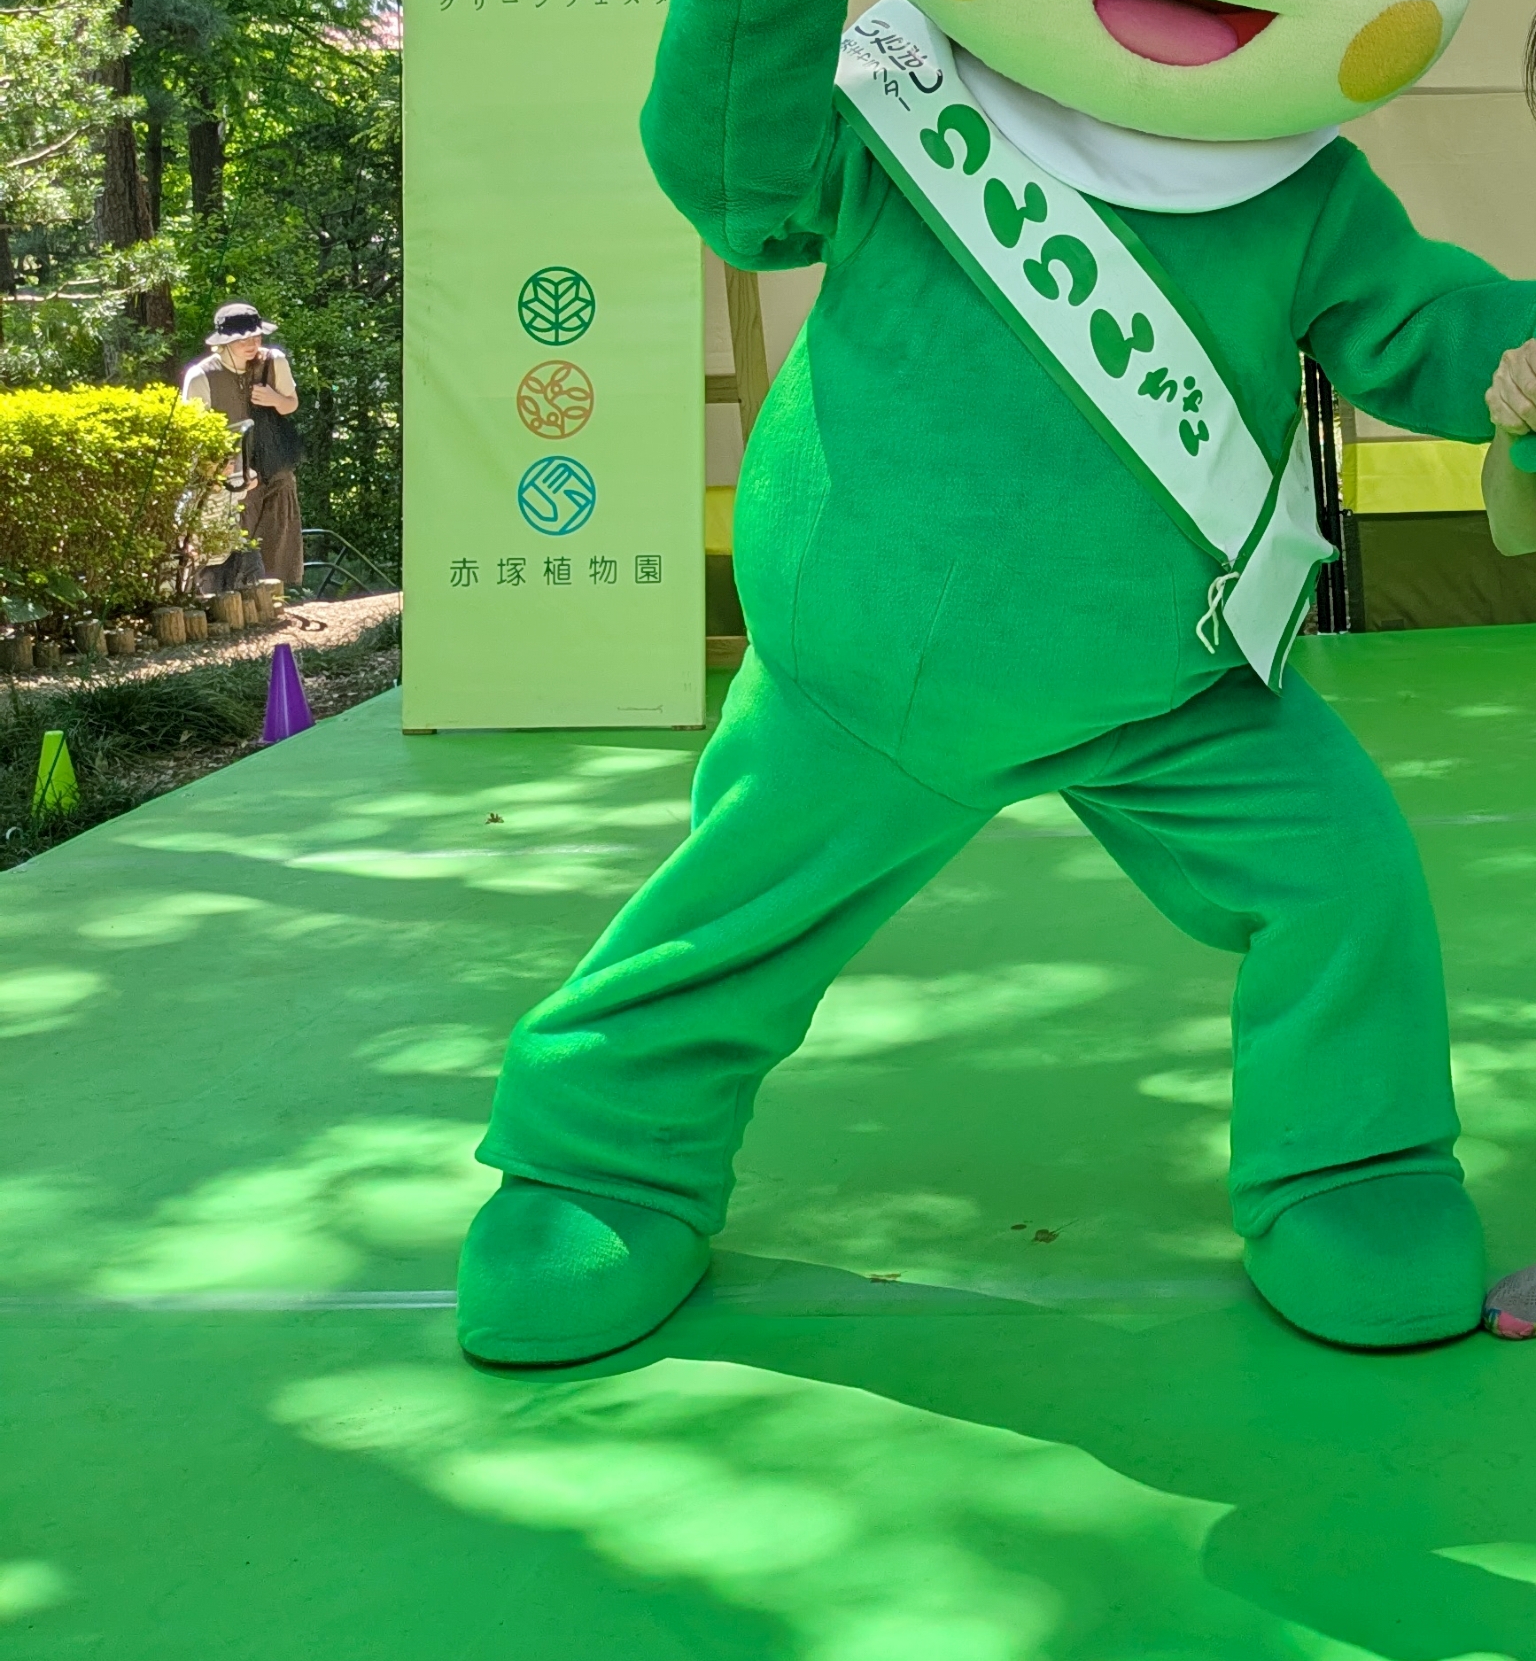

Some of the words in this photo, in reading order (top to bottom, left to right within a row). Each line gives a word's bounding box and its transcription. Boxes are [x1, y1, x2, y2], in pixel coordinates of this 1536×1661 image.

[854, 19, 943, 94] いたばし
[919, 103, 1210, 457] りんりんちゃん
[449, 554, 662, 587] 赤塚植物園
